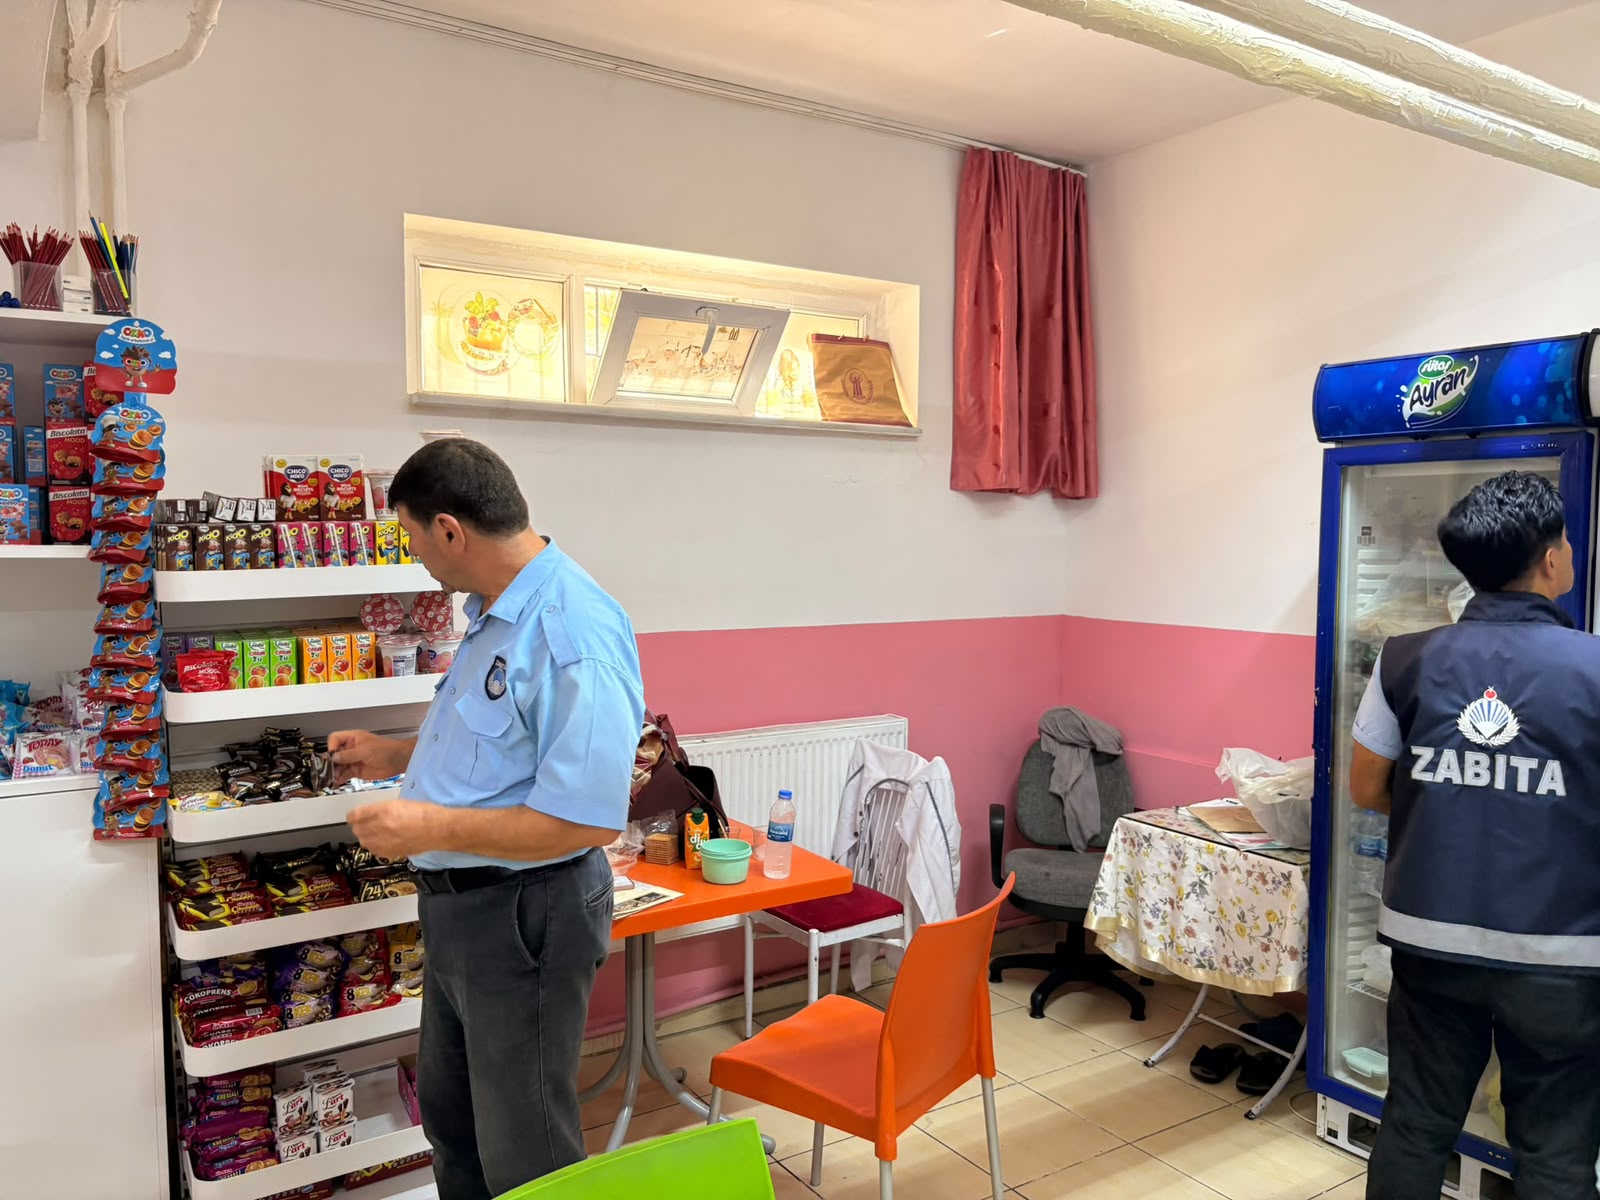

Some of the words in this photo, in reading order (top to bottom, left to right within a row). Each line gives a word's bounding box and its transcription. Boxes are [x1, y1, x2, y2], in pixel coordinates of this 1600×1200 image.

[1409, 367, 1467, 411] Ayran
[51, 428, 86, 437] Biscolata
[52, 490, 88, 499] Biscolata
[26, 738, 62, 752] TODAY
[23, 764, 54, 773] Donut
[1410, 745, 1567, 797] ZABITA
[184, 988, 232, 1004] ÇOKOPRENS
